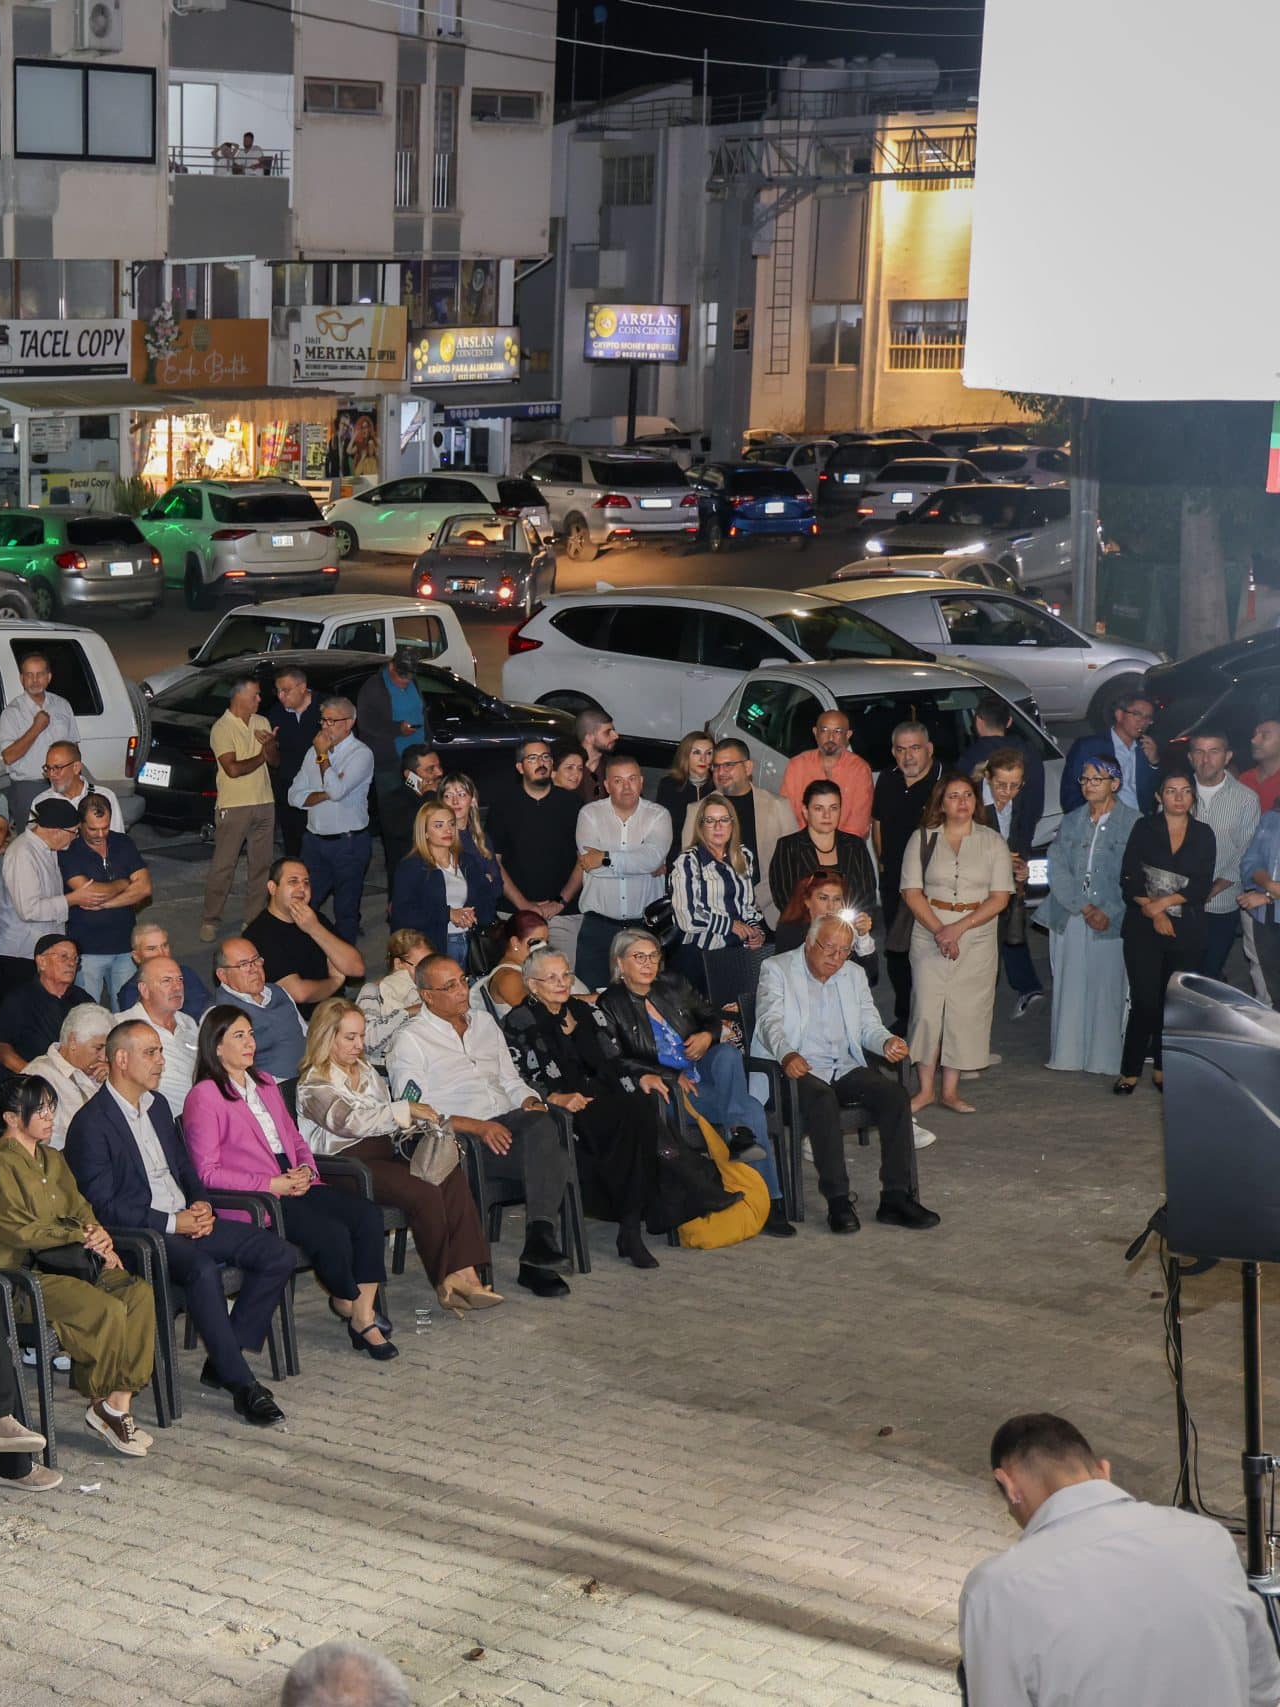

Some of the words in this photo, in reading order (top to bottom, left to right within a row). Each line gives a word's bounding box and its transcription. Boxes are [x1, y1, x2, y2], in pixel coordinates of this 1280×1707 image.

[620, 313, 678, 326] ARSLAN
[619, 326, 640, 334] COIN
[642, 327, 677, 335] CENTER
[20, 330, 71, 358] TACEL
[77, 328, 125, 357] COPY
[456, 336, 494, 348] ARSLAN
[305, 347, 375, 360] MERTKAL
[91, 477, 111, 489] Copy
